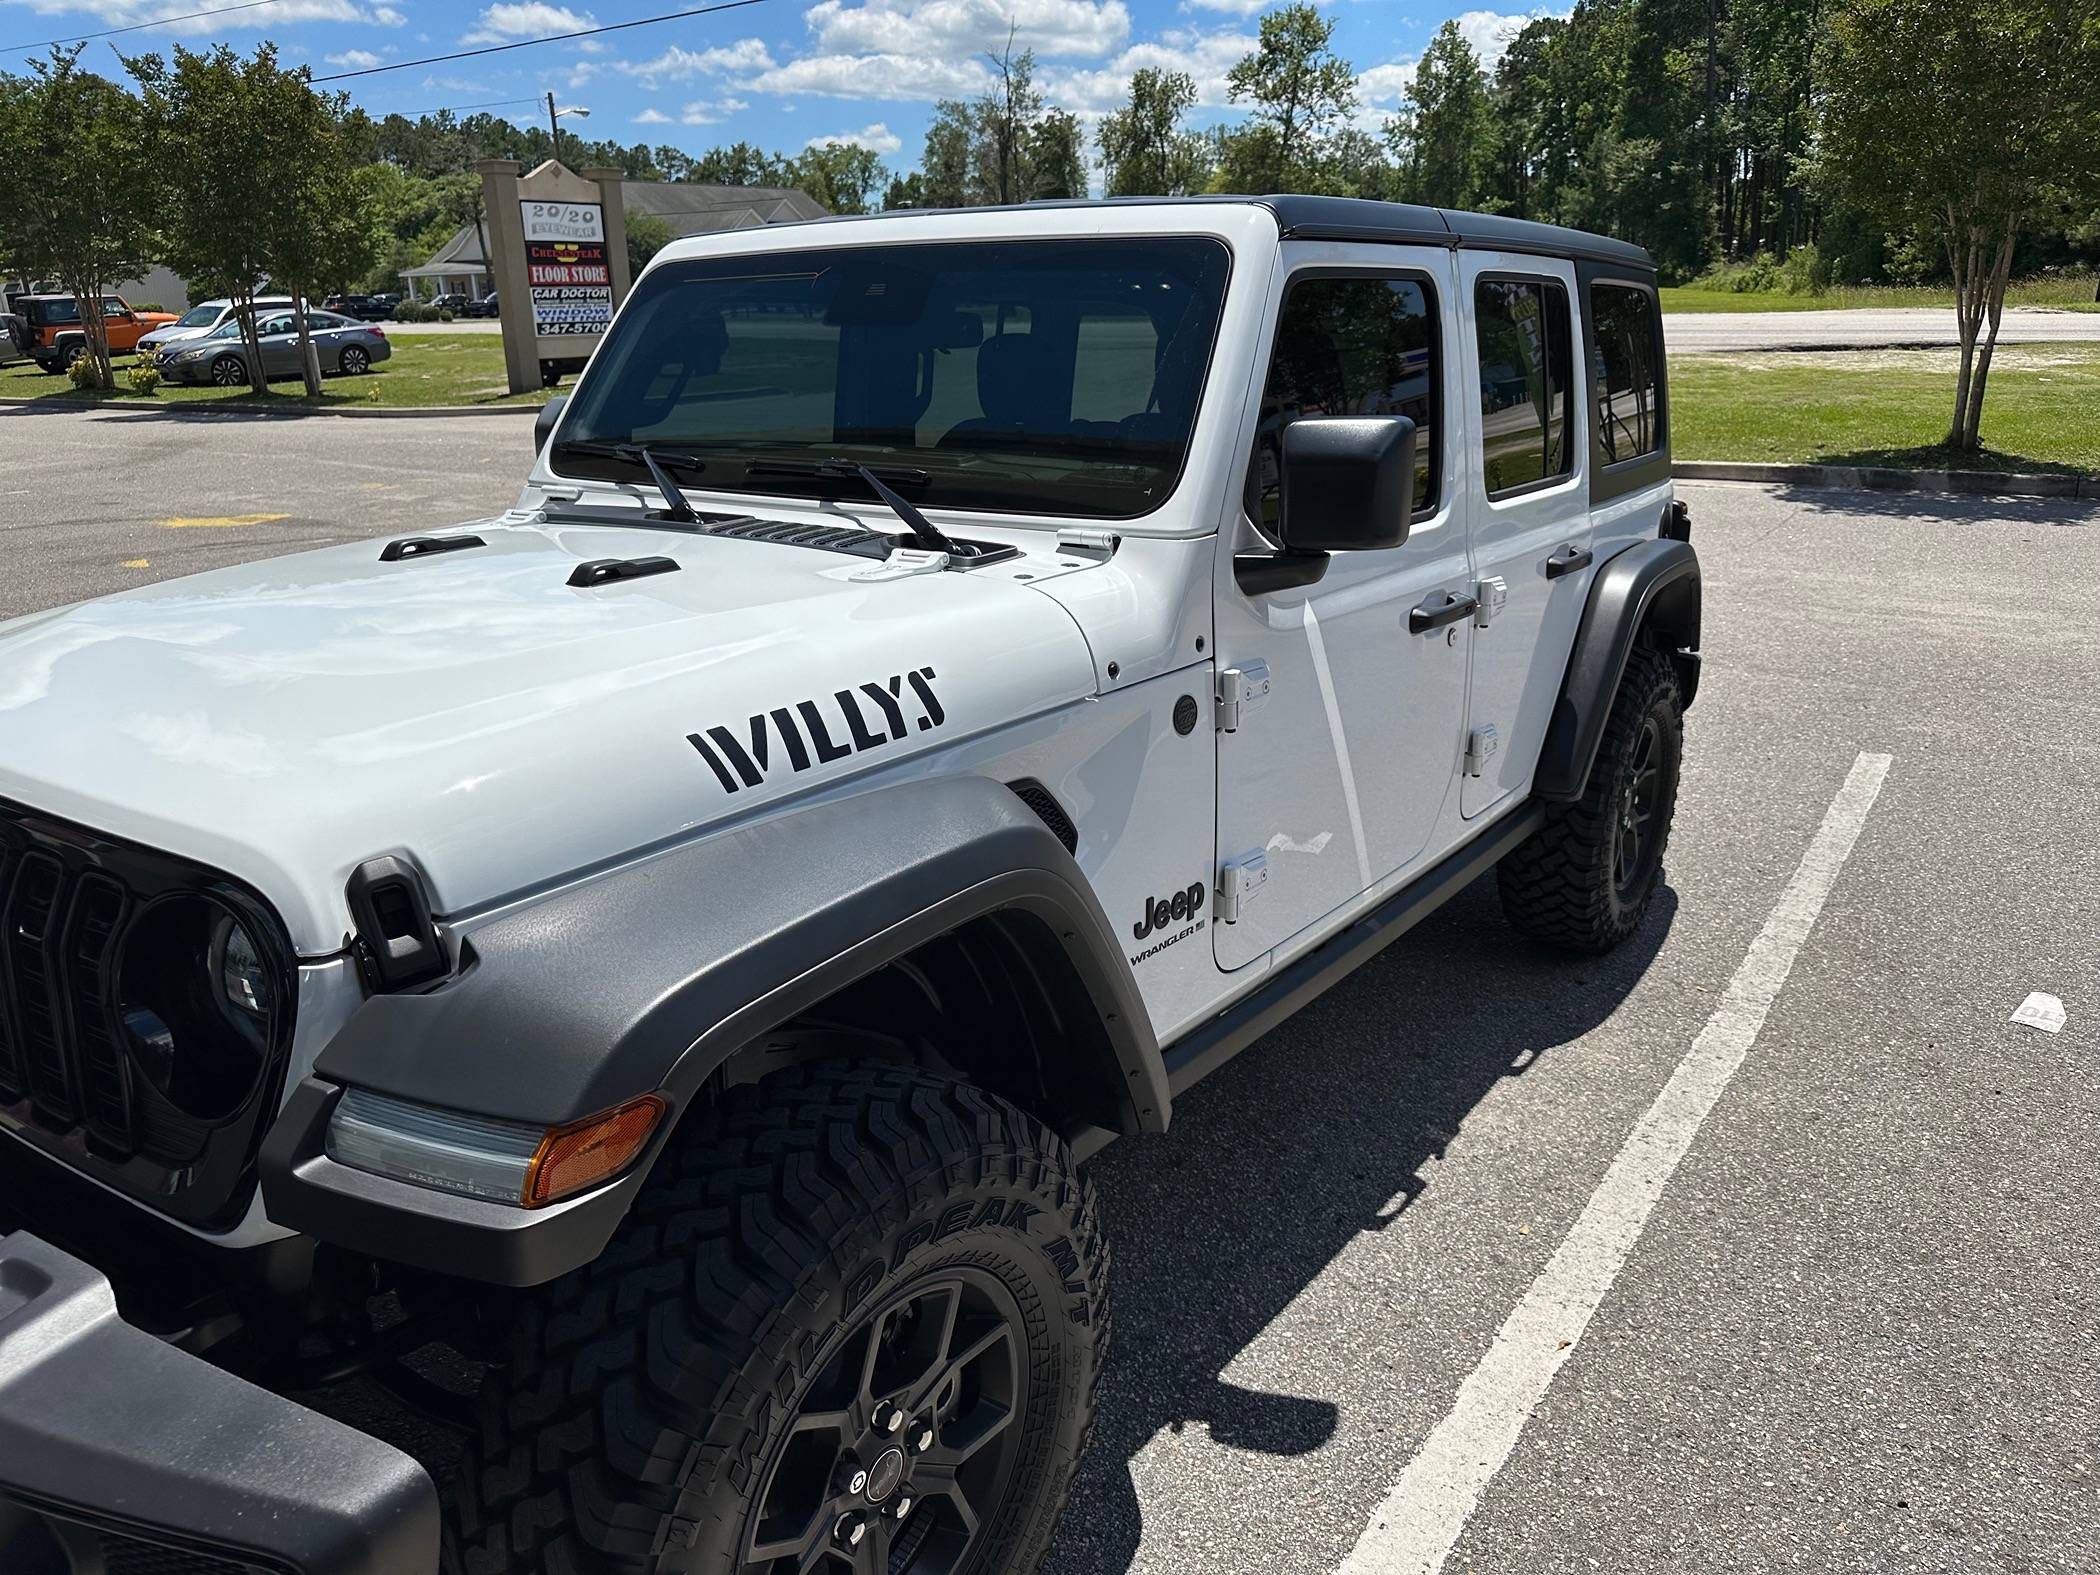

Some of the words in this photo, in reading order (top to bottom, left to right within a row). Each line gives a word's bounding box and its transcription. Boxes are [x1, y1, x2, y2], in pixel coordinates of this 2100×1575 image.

[532, 205, 594, 223] 20/20
[535, 223, 593, 237] EYEWEAR
[532, 266, 569, 283] FLOOR
[571, 266, 607, 283] STORE
[534, 289, 558, 298] CAR
[561, 289, 608, 298] DOCTOR
[540, 323, 609, 335] 347-5700
[686, 666, 945, 794] WILLYS
[1133, 881, 1205, 940] Jeep
[1130, 925, 1194, 967] WRANGLER
